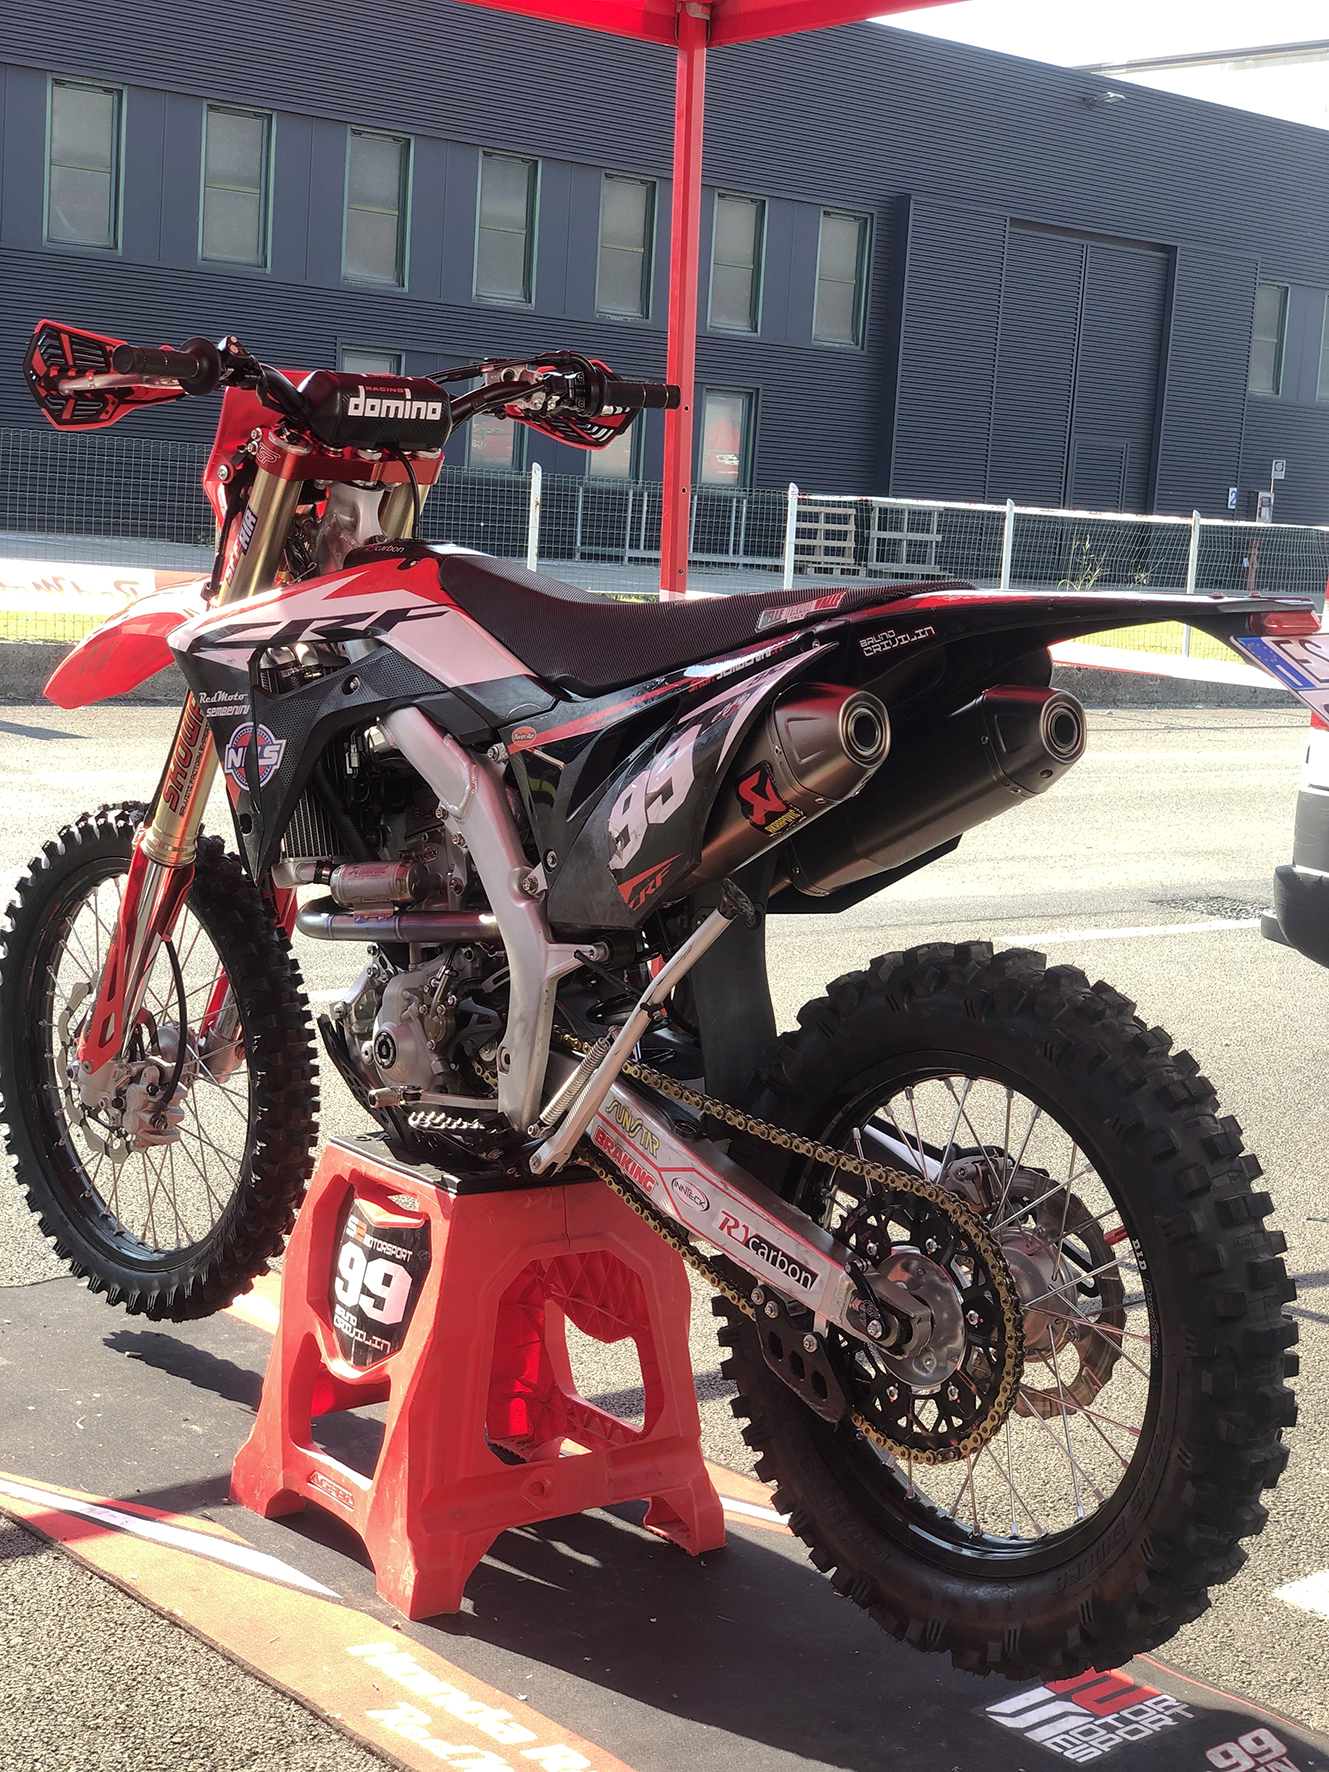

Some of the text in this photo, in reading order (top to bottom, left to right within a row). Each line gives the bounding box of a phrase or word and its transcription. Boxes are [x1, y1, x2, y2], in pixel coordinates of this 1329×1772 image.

[348, 385, 442, 420] domino
[366, 386, 404, 394] RACING
[1229, 490, 1237, 506] 2
[859, 628, 897, 648] BRUNO
[862, 625, 936, 657] CRIVILIN
[199, 690, 249, 704] RedMoto
[605, 1099, 660, 1159] SUNSTAR
[594, 1127, 657, 1195] BRAKING
[334, 1240, 413, 1325] 99
[748, 1236, 813, 1291] carbon
[1041, 1694, 1183, 1753] MOTOR
[1063, 1706, 1195, 1764] SPORT
[1204, 1726, 1289, 1772] 99
